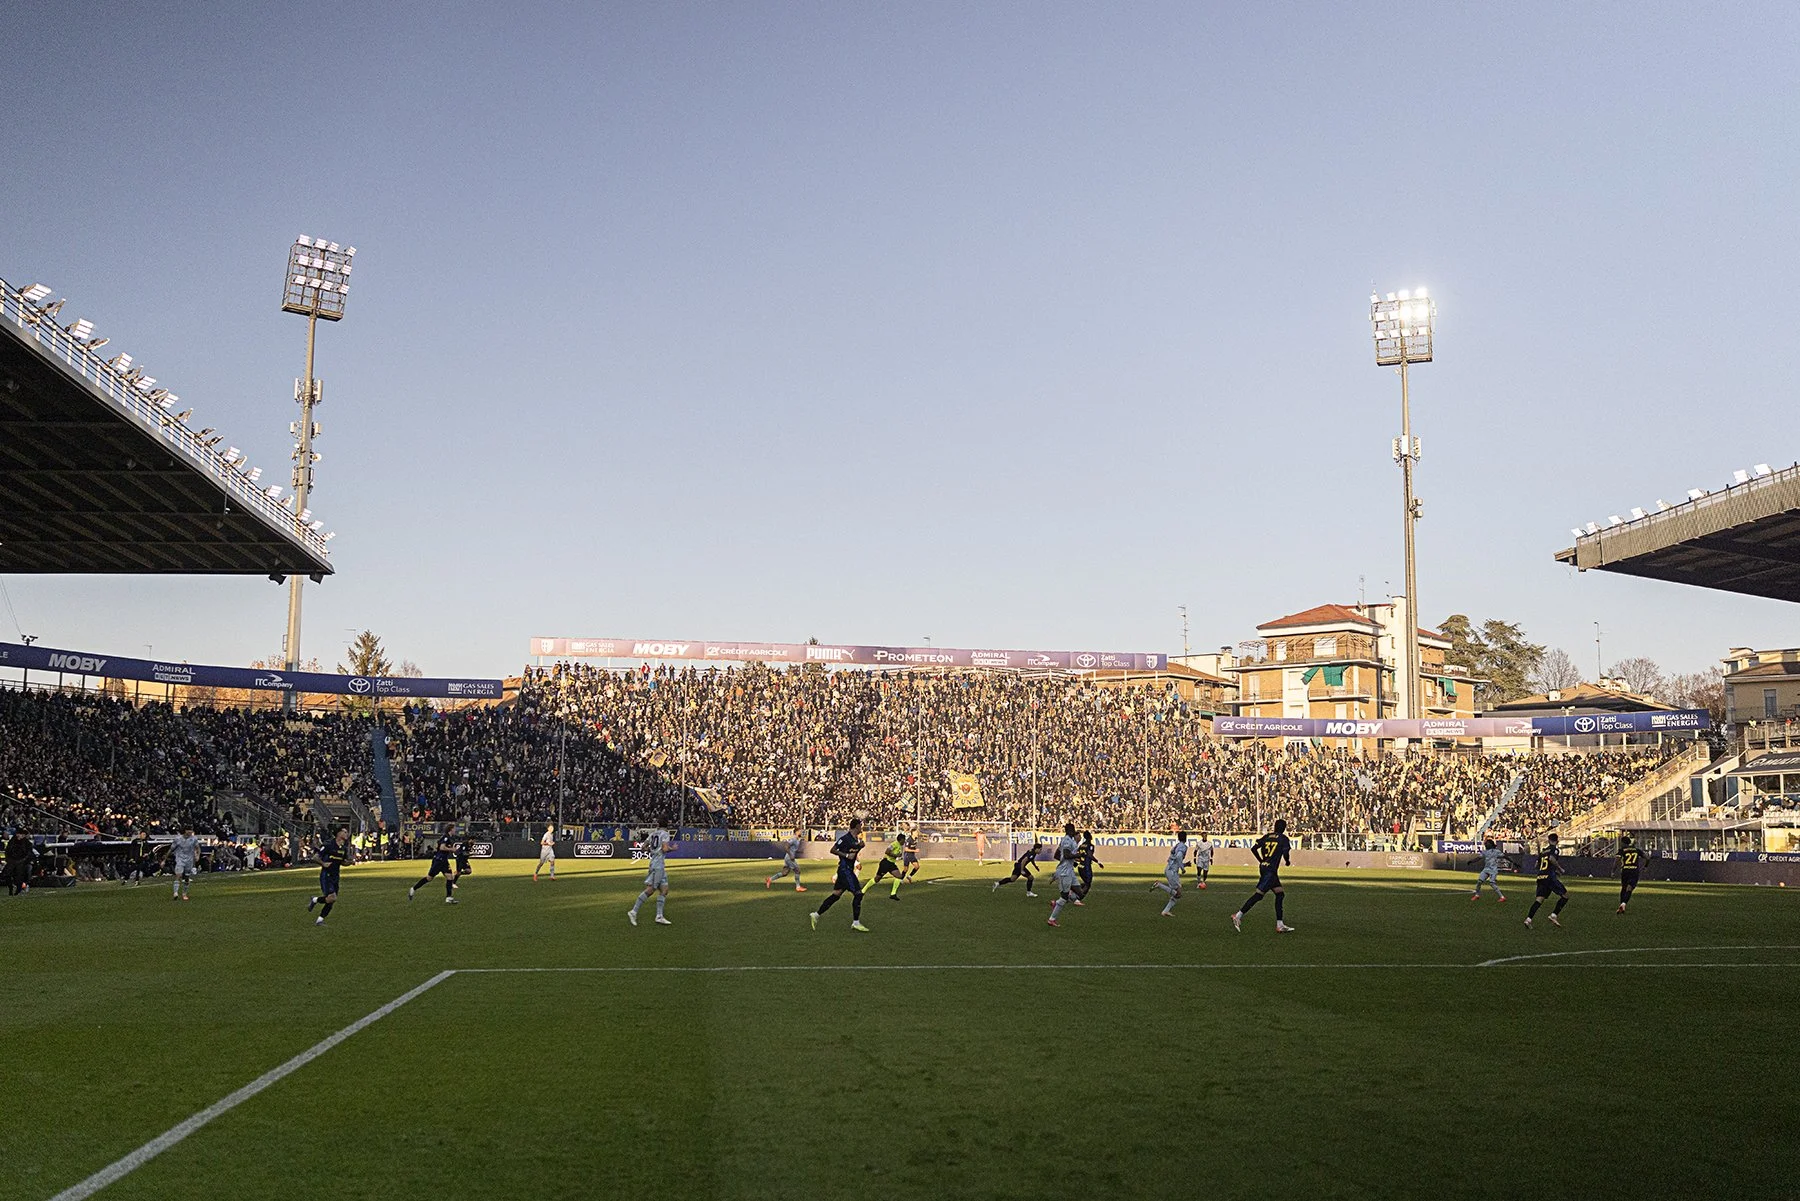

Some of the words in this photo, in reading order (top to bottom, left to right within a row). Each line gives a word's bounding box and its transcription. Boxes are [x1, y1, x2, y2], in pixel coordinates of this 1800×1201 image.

[633, 643, 690, 656] MOBY
[749, 649, 788, 657] AGRICOLE
[807, 647, 842, 660] PUMA
[873, 650, 954, 663] PROMETEON
[971, 651, 1011, 660] ADMIRAL
[48, 653, 106, 672] MOBY
[1027, 659, 1059, 667] ITCompany
[152, 663, 196, 675] ADMIRAL
[255, 678, 293, 690] ITCompany
[1600, 715, 1617, 723] Zatti
[1235, 722, 1263, 730] CRÉDIT
[1325, 722, 1383, 734] MOBY
[1423, 720, 1468, 729] ADMIRAL
[1600, 722, 1613, 730] Top
[1505, 726, 1542, 735] ITCompany
[681, 833, 690, 841] 19
[1095, 837, 1138, 846] NORD
[1265, 841, 1278, 857] 37
[1625, 852, 1638, 864] 27
[1699, 852, 1730, 862] MOBY
[1540, 857, 1549, 871] 15
